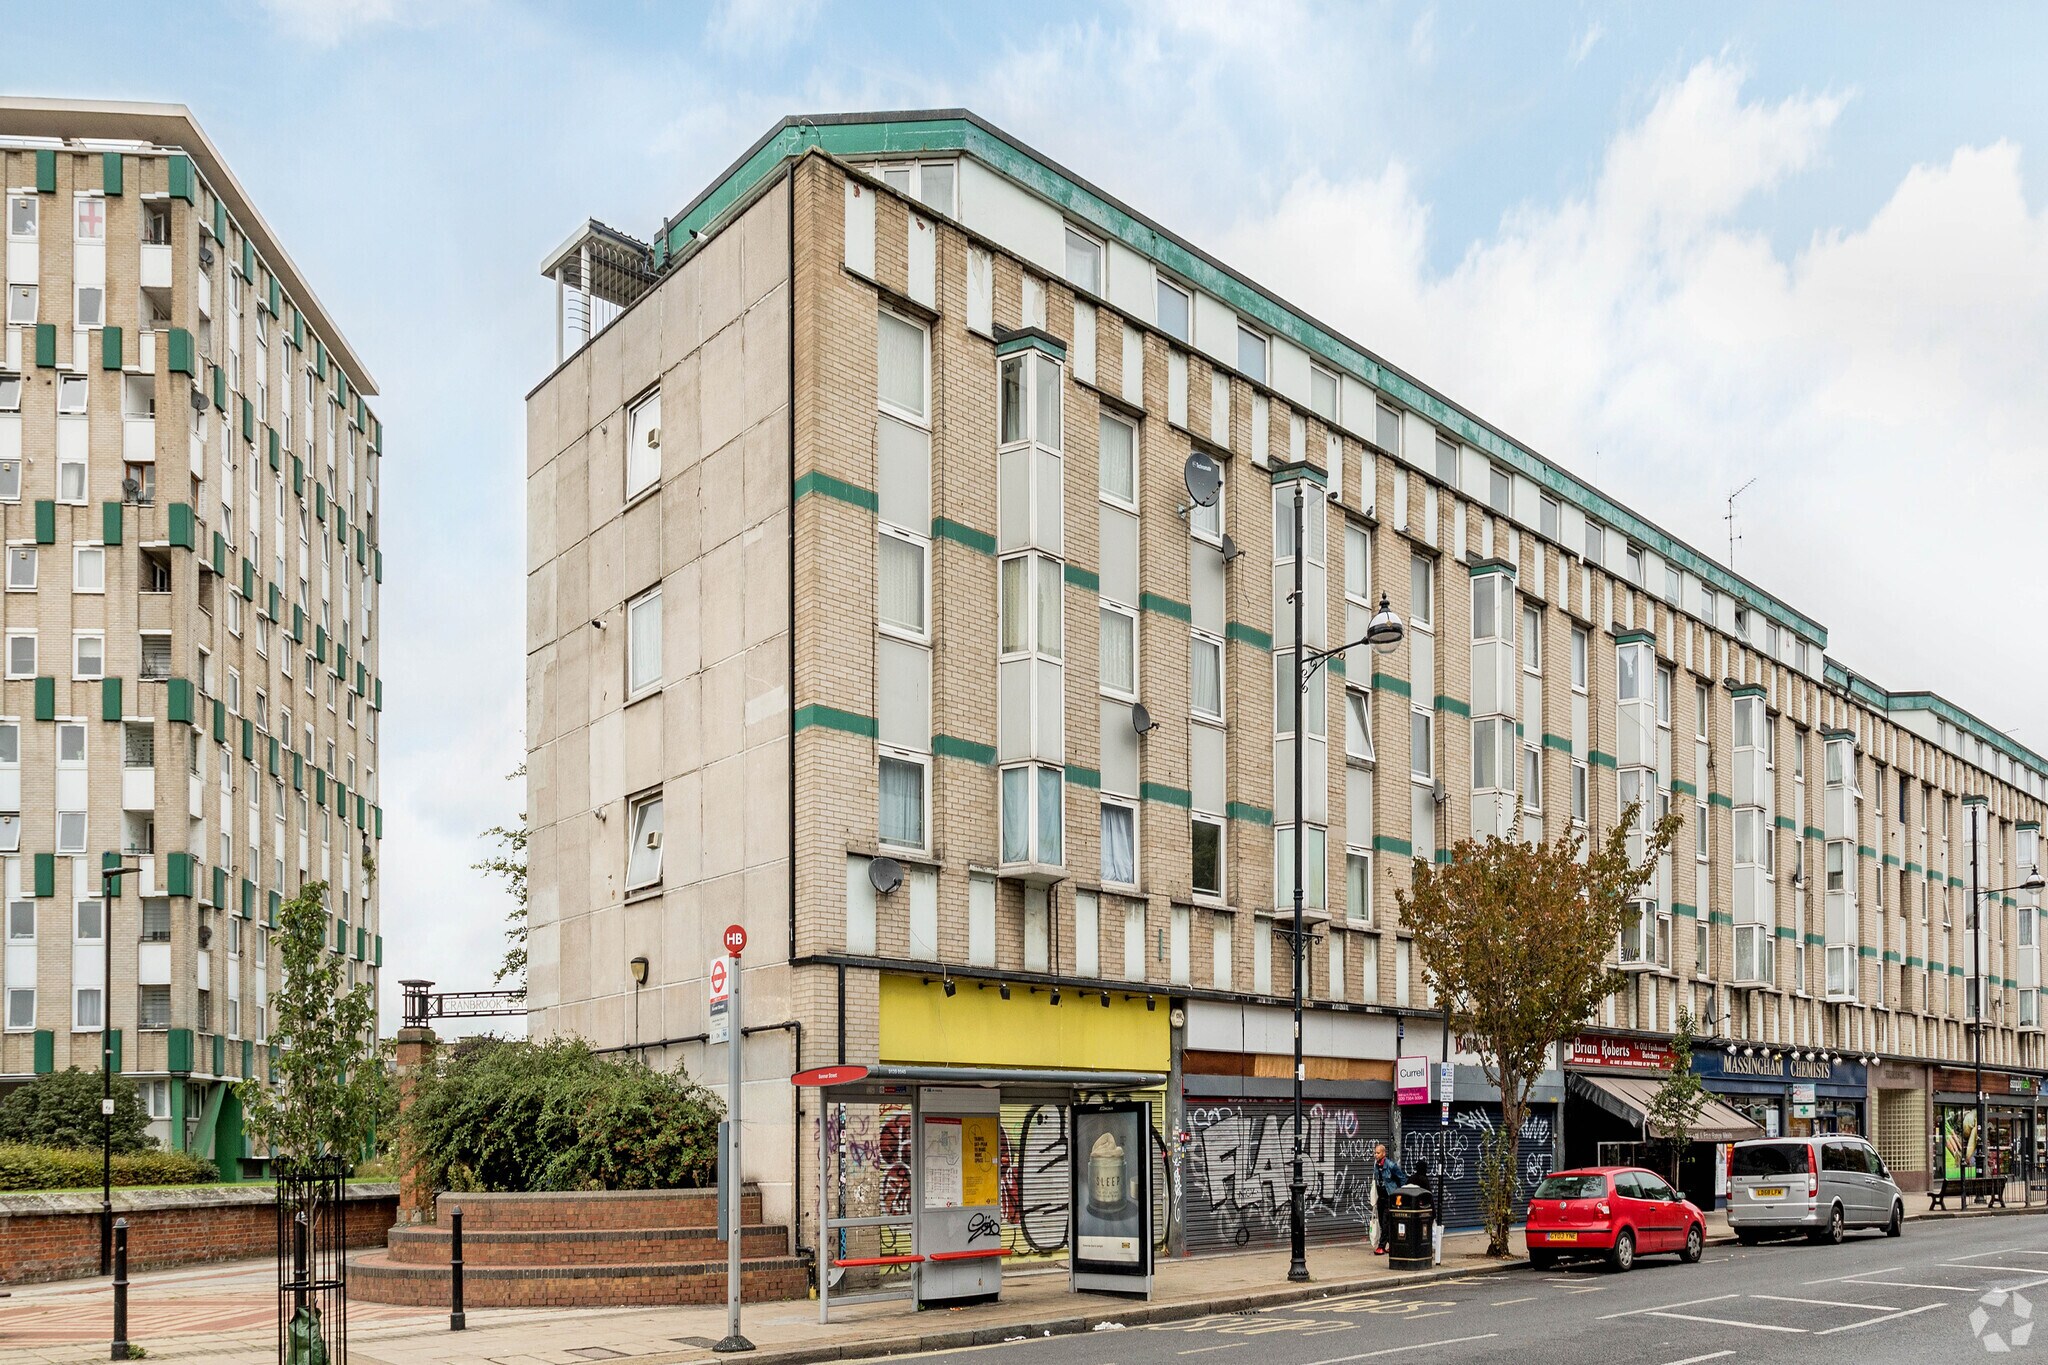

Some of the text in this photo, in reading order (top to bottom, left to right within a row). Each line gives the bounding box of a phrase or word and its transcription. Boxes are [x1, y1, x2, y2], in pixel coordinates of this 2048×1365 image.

[726, 933, 743, 945] HB
[444, 999, 528, 1011] CRANBROOK EST
[1574, 1037, 1630, 1059] Brian Roberts
[1639, 1042, 1648, 1051] Old
[1400, 1068, 1425, 1078] Currell
[1723, 1055, 1830, 1079] MASSINGHAM CHEMISTS
[1096, 1176, 1120, 1187] SLEEP
[1550, 1232, 1565, 1240] GY03
[1293, 1299, 1457, 1314] BUS
[1147, 1317, 1355, 1335] STOP
